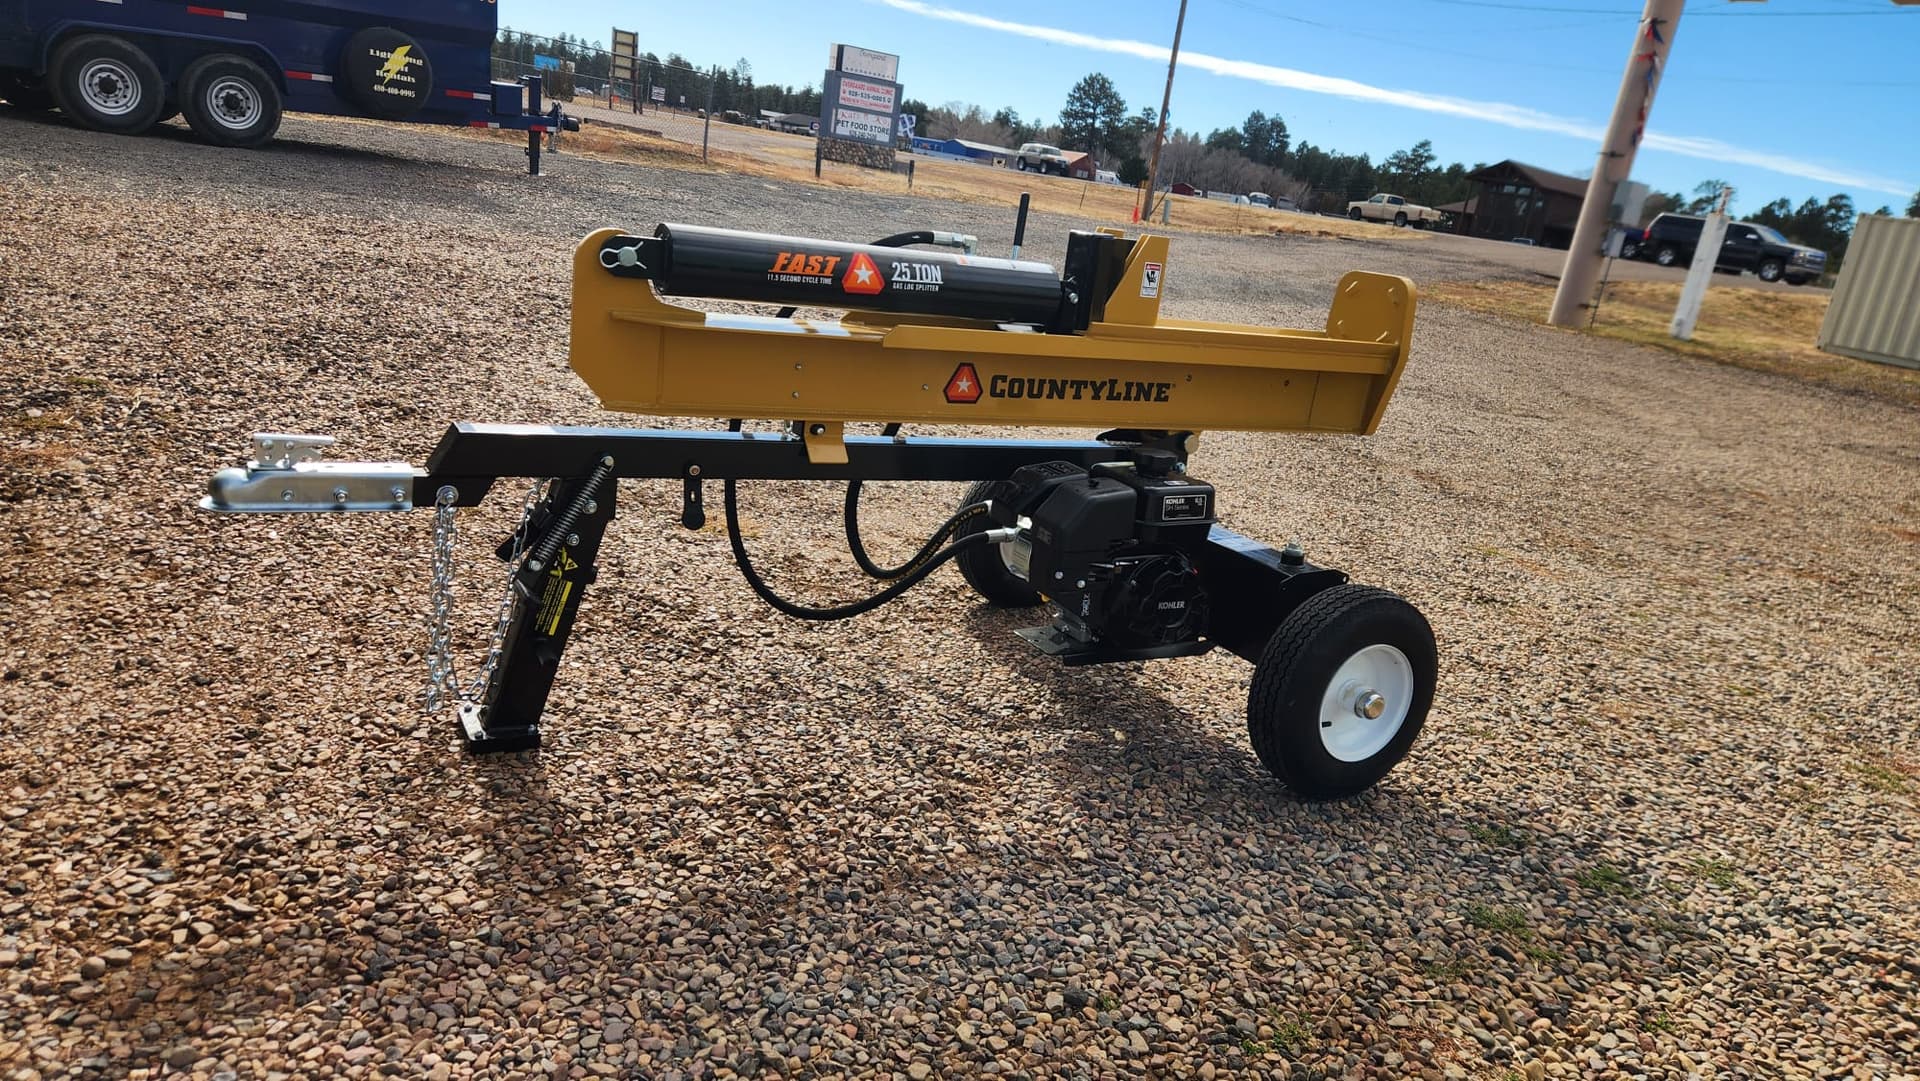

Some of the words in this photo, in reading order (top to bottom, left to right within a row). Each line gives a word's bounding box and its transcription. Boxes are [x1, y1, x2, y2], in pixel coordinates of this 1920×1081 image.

[369, 48, 424, 66] Lighing
[836, 120, 849, 128] PET
[850, 122, 869, 132] FOOD
[869, 125, 890, 135] STORE
[772, 252, 841, 275] FAST
[780, 274, 801, 282] SECOND
[802, 276, 818, 284] CYCLE
[892, 262, 911, 281] 25
[912, 263, 942, 282] TON
[915, 284, 939, 292] SPLITTER
[1157, 601, 1185, 610] KOHLER
